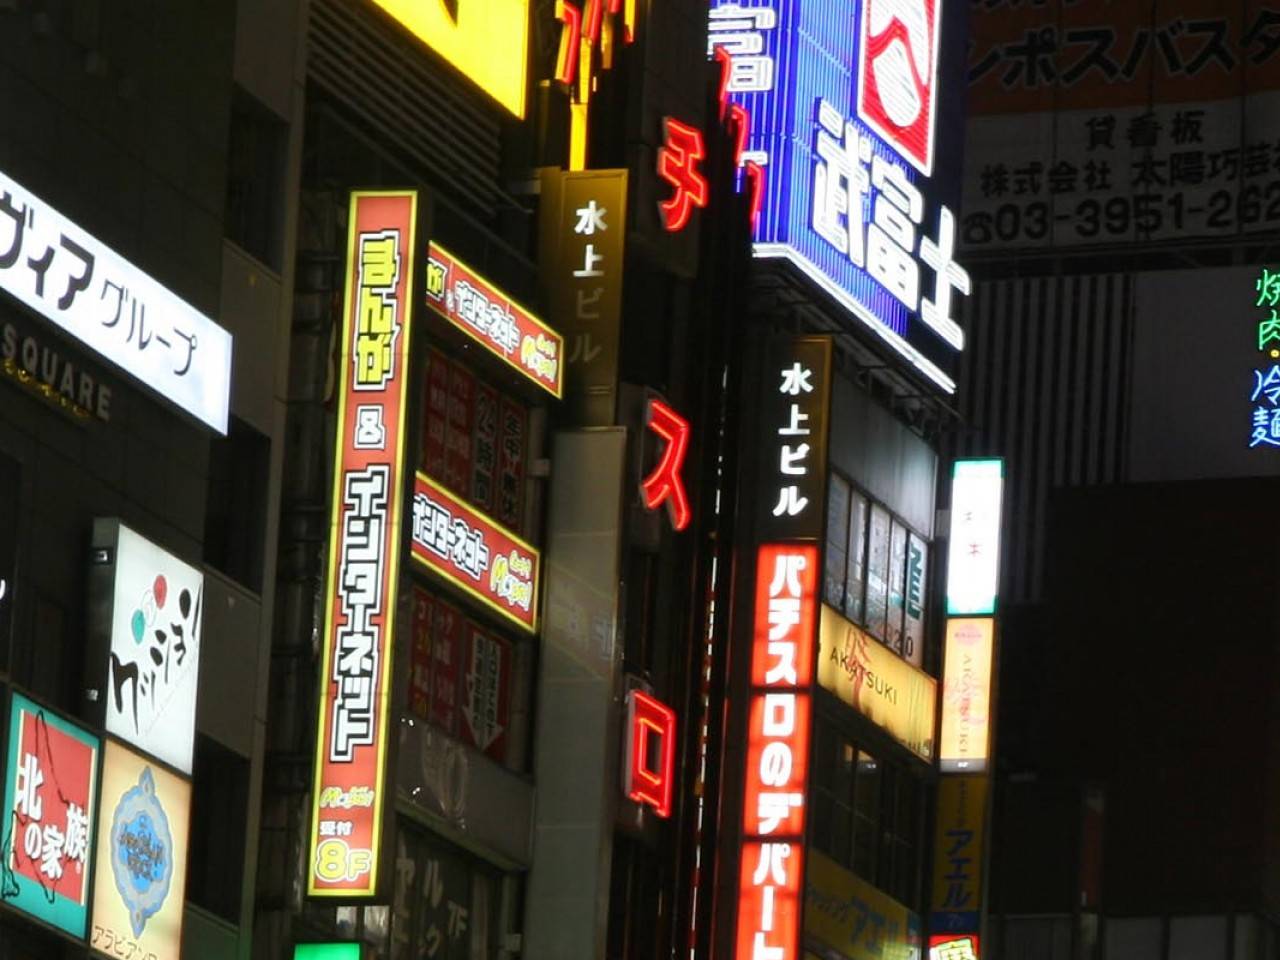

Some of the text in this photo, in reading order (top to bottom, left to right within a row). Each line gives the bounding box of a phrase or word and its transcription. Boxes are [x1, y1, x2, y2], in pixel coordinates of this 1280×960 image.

[980, 162, 1112, 196] 株式会社
[1085, 111, 1204, 148] 貸看板
[568, 200, 609, 361] 水上ビル
[812, 98, 971, 351] 武富士
[2, 325, 111, 420] SQUARE
[355, 232, 399, 390] まんが
[773, 362, 813, 517] 水上ビル
[15, 753, 88, 880] 北の家族
[314, 838, 373, 883] 8F
